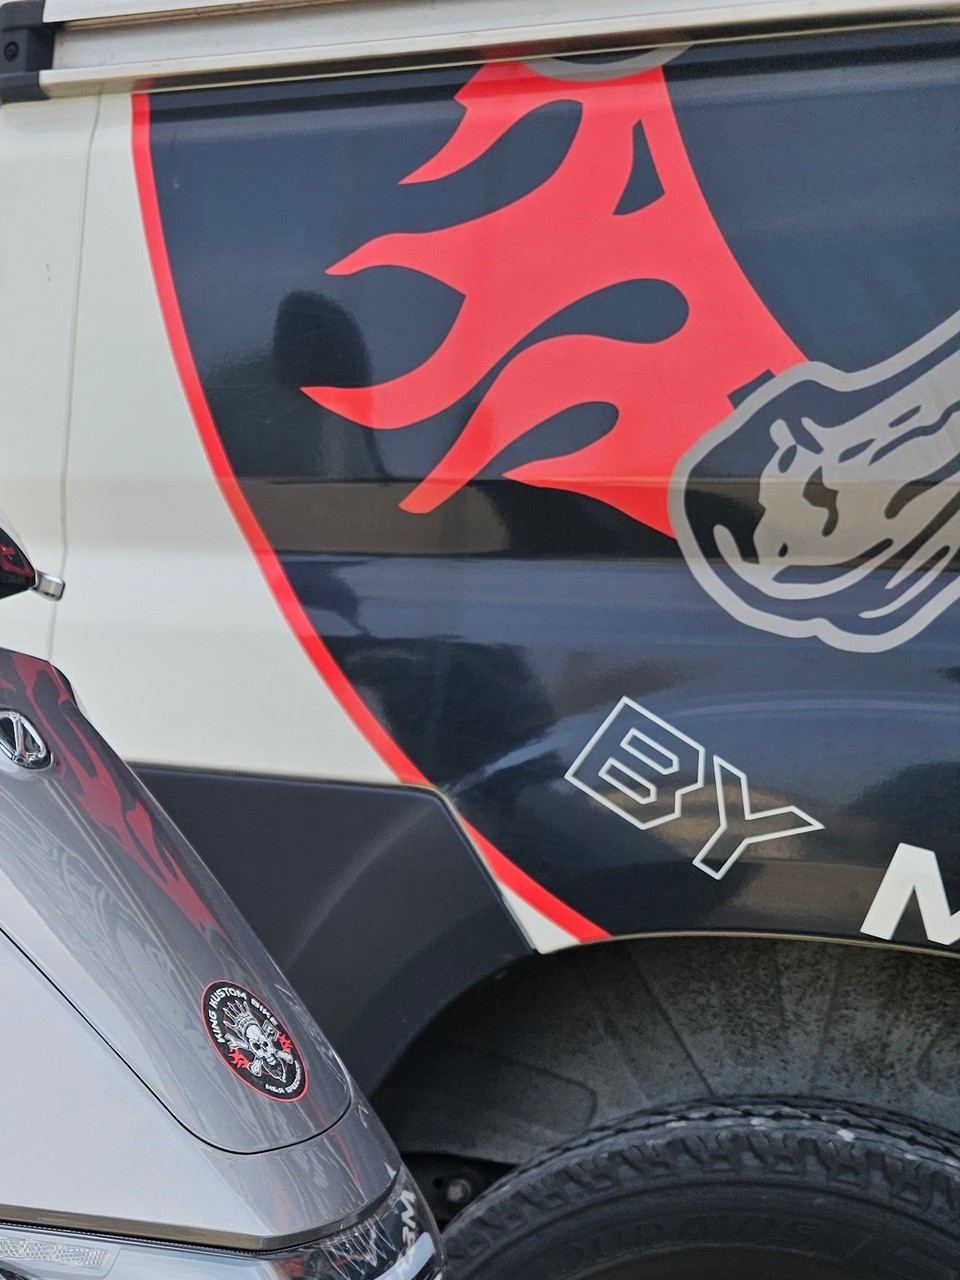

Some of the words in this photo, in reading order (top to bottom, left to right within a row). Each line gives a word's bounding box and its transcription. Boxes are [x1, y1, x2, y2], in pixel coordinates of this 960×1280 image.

[564, 696, 826, 880] BY
[208, 987, 248, 1010] KUSTOM
[250, 998, 279, 1026] BIKE
[208, 1009, 226, 1043] KING
